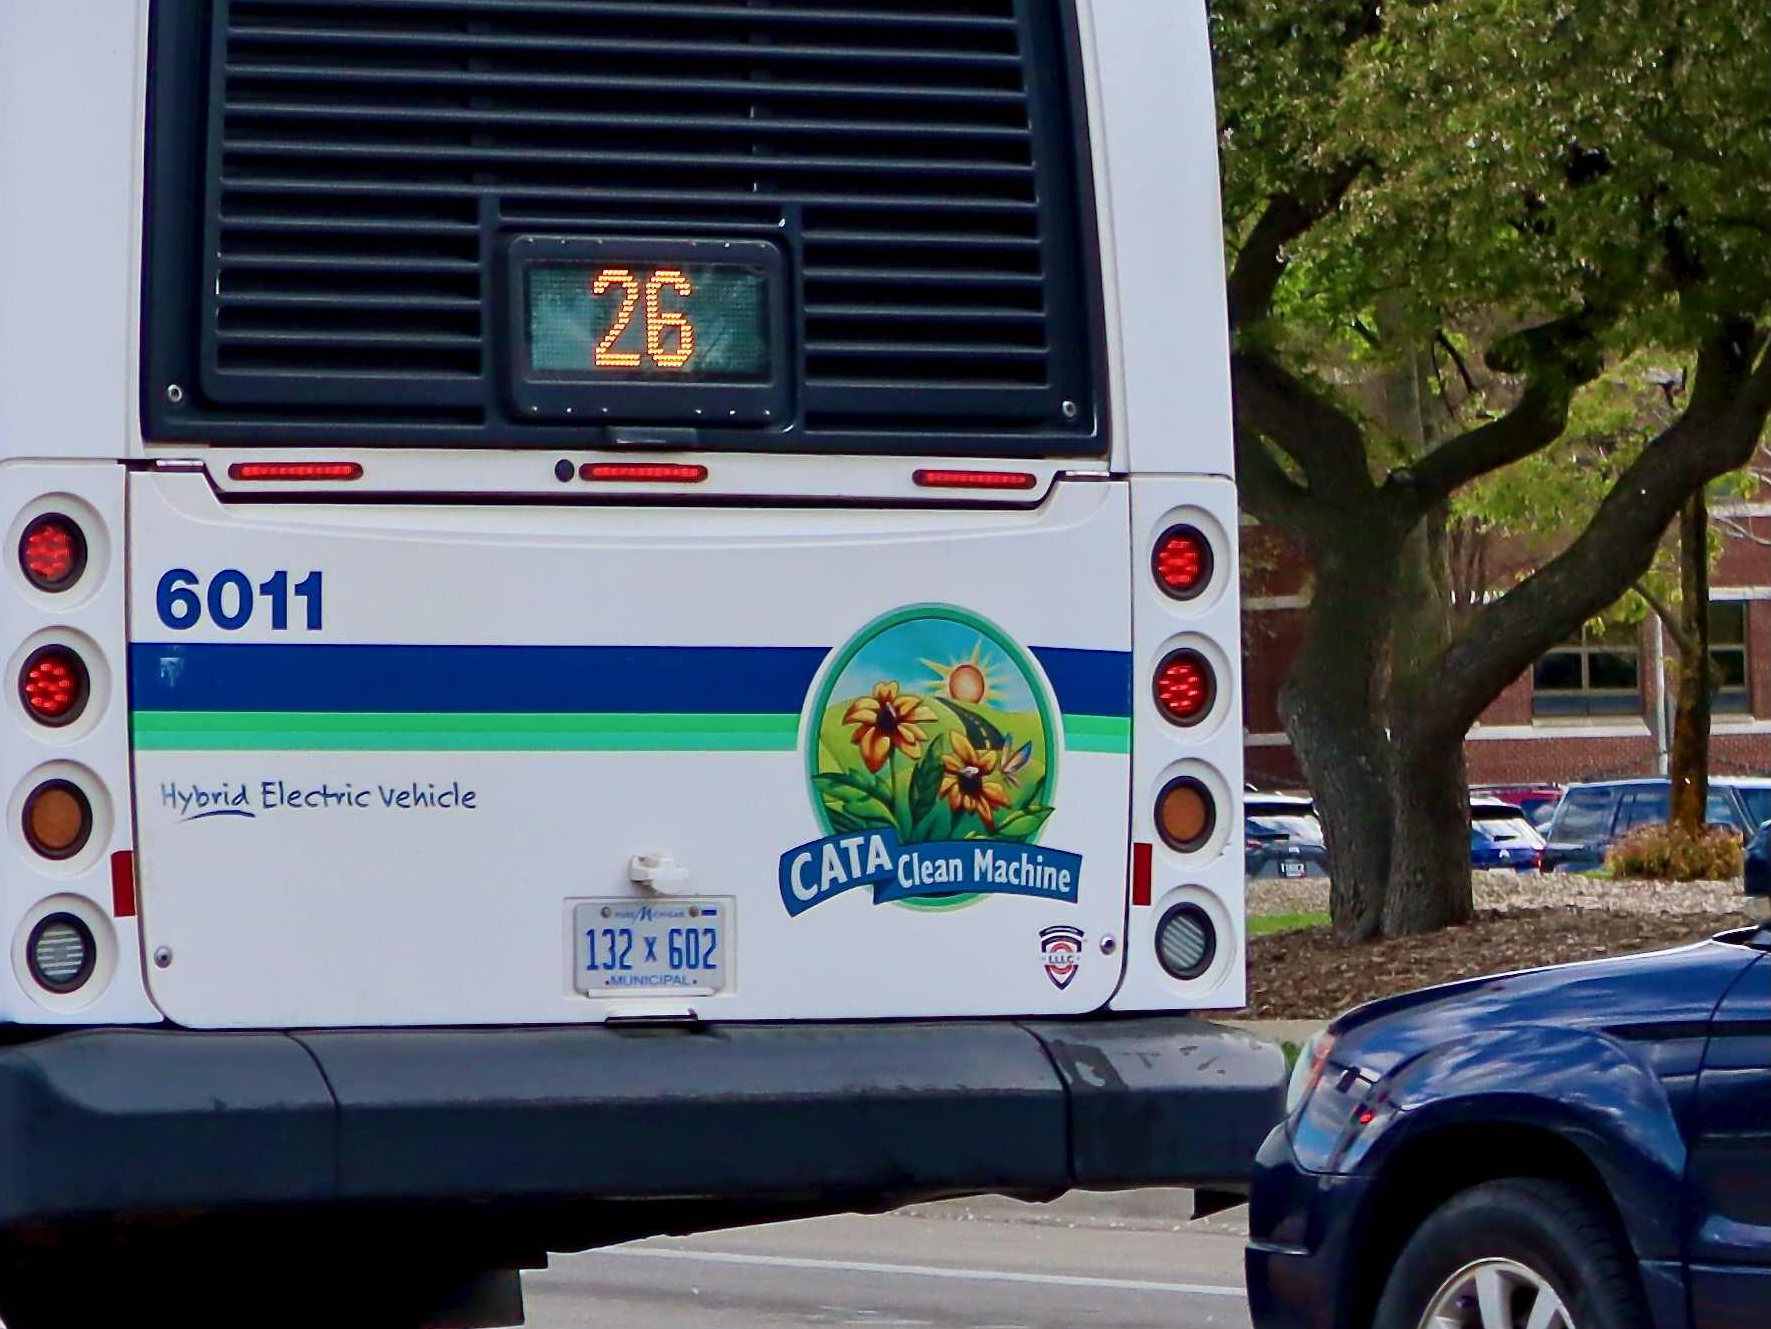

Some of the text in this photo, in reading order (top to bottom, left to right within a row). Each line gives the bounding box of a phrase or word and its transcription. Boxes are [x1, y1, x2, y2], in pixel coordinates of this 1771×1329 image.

[591, 268, 694, 367] 26
[155, 568, 324, 631] 6011
[160, 781, 477, 815] Hybrid Electric Vehicle
[790, 834, 1071, 902] CATA Clean Machine
[585, 928, 633, 971] 132
[668, 928, 717, 970] 602
[609, 974, 690, 986] MUNICIPAL
